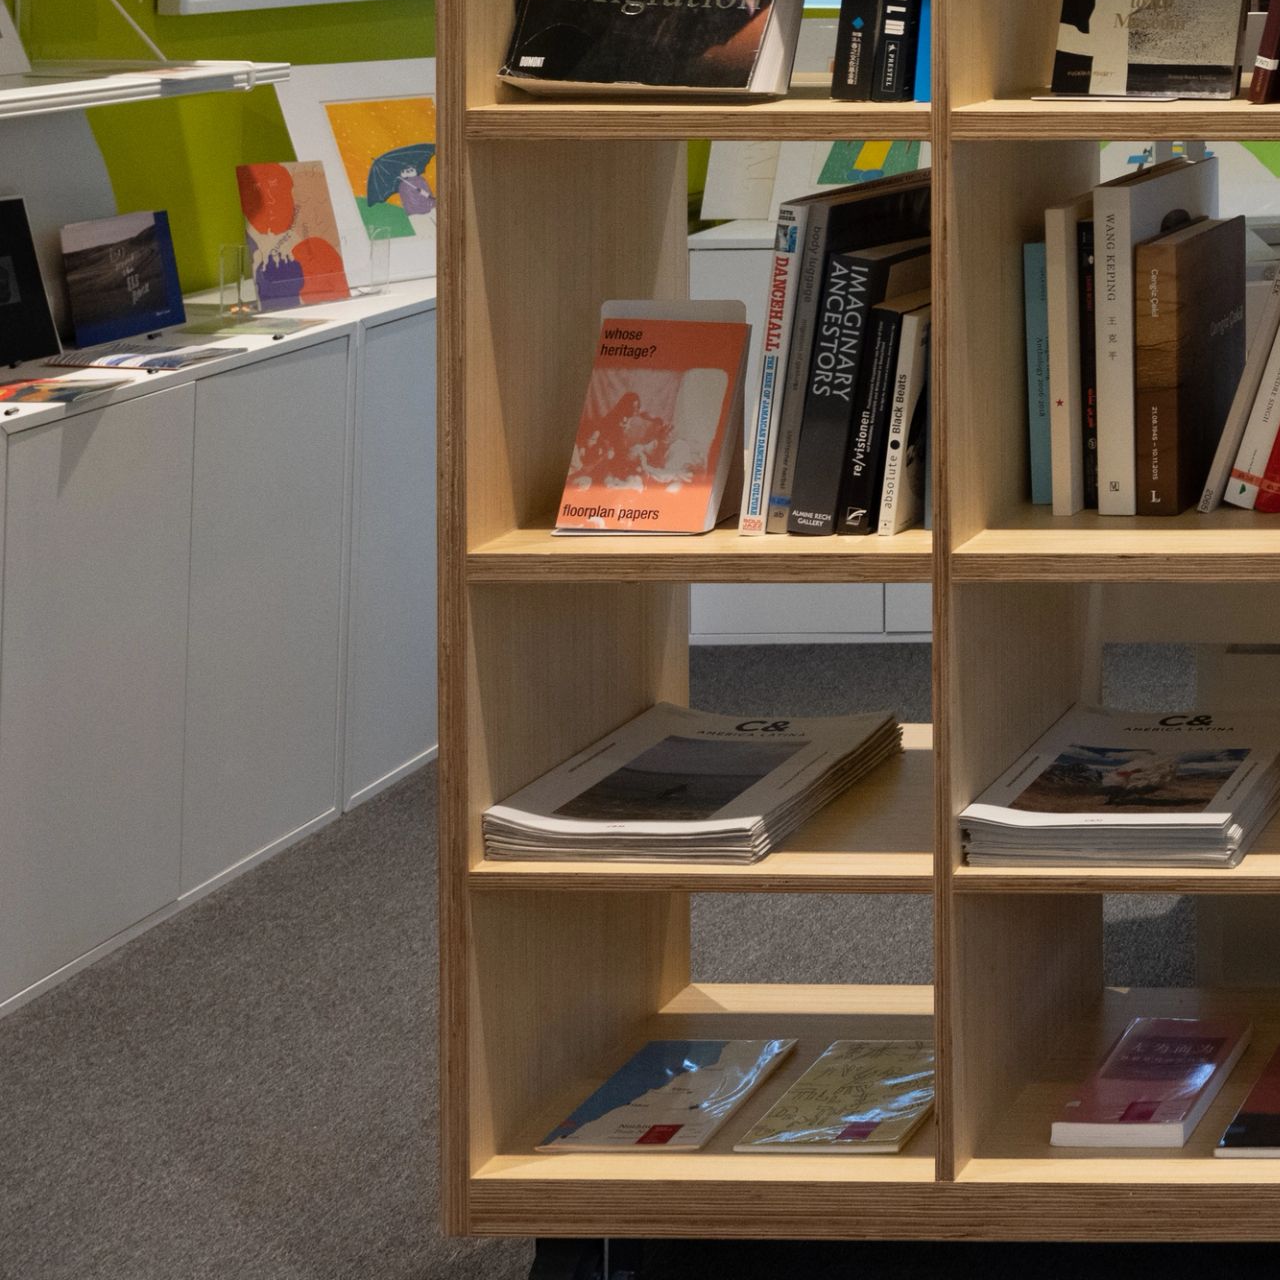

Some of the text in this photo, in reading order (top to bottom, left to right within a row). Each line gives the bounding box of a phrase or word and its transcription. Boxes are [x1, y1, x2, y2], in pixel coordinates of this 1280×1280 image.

[1106, 214, 1116, 302] WANG KEPING
[765, 256, 789, 352] DANCEHALL
[812, 261, 849, 397] ANCESTORS
[600, 344, 656, 360] heritage?
[605, 328, 643, 341] whose
[832, 265, 868, 401] IMAGINARY
[884, 374, 907, 509] absolute Black Beats
[562, 505, 660, 522] floorplan papers
[734, 719, 792, 734] C&
[1158, 715, 1214, 729] C&
